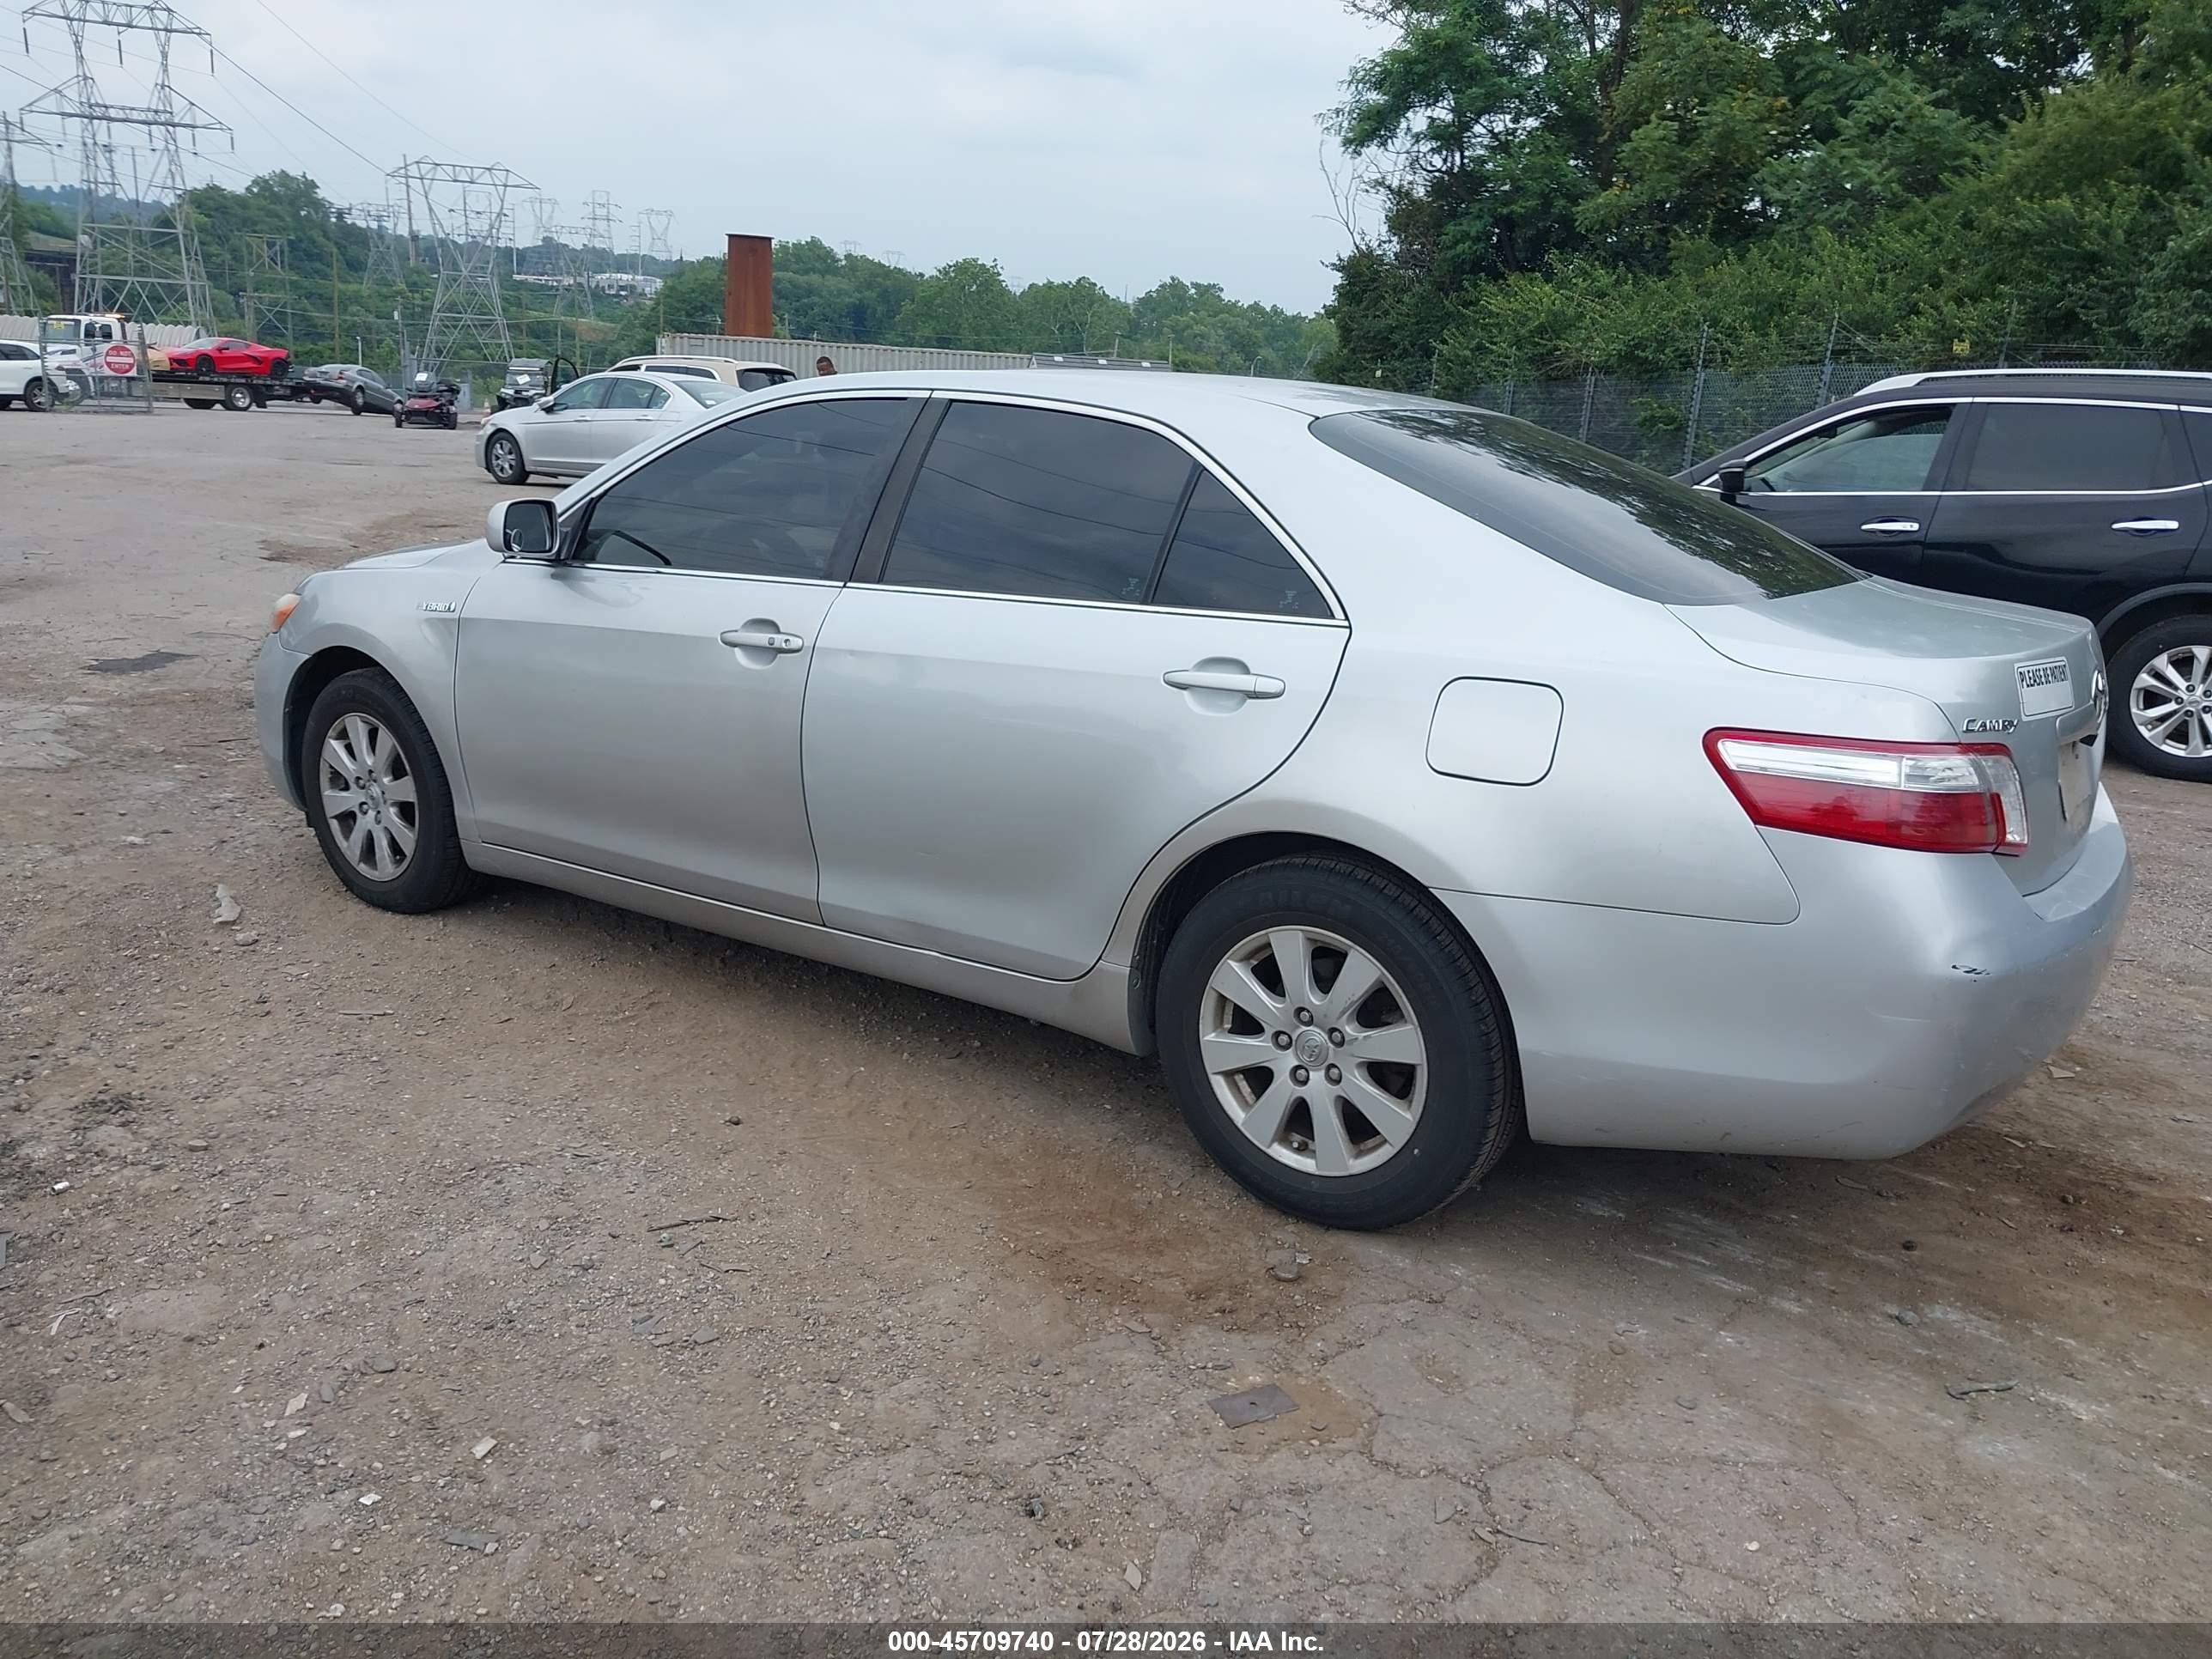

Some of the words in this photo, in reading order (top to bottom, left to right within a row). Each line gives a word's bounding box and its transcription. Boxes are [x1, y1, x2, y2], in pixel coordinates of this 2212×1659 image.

[2019, 669, 2044, 689] PLEASE
[2042, 667, 2051, 685] BE
[2050, 664, 2068, 684] PATIENT
[1962, 718, 2019, 734] CAMRY
